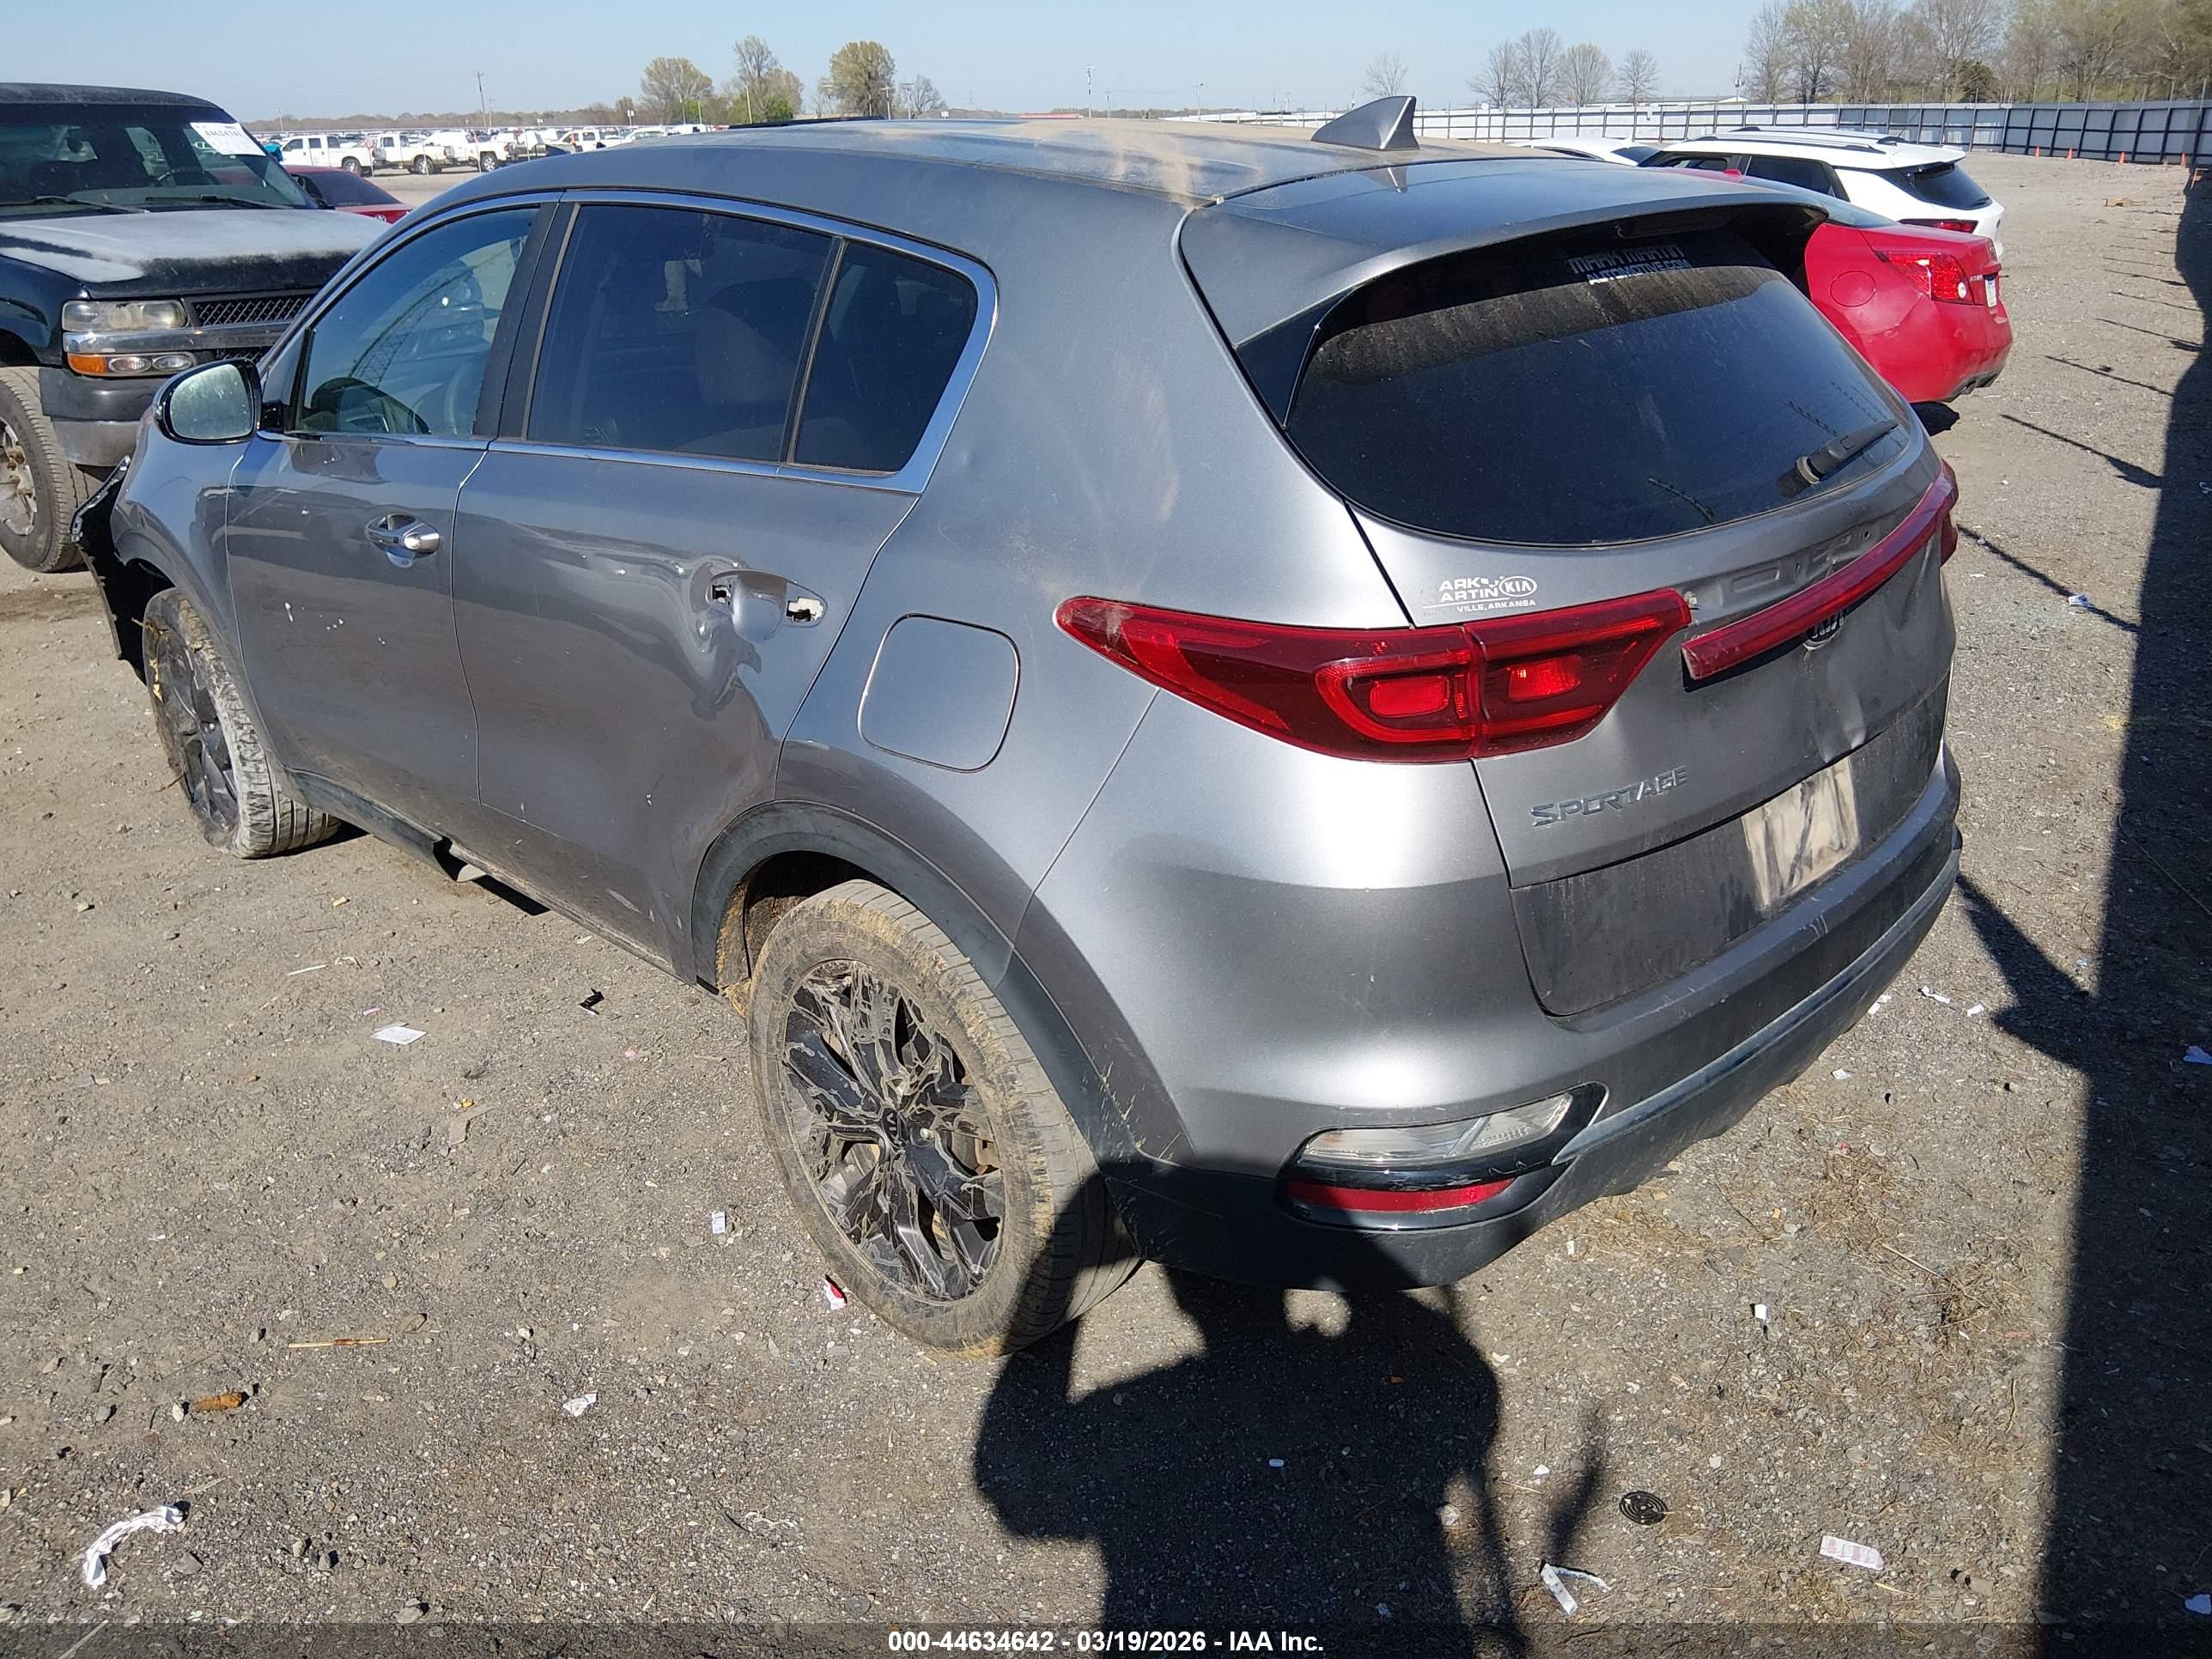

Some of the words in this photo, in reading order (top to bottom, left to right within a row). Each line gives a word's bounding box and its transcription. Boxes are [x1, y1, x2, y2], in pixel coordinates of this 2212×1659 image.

[1567, 250, 1625, 274] MARK
[1623, 244, 1685, 264] MARTIN
[1504, 580, 1532, 593] KIA
[1529, 765, 1689, 827] SPORTAGE
